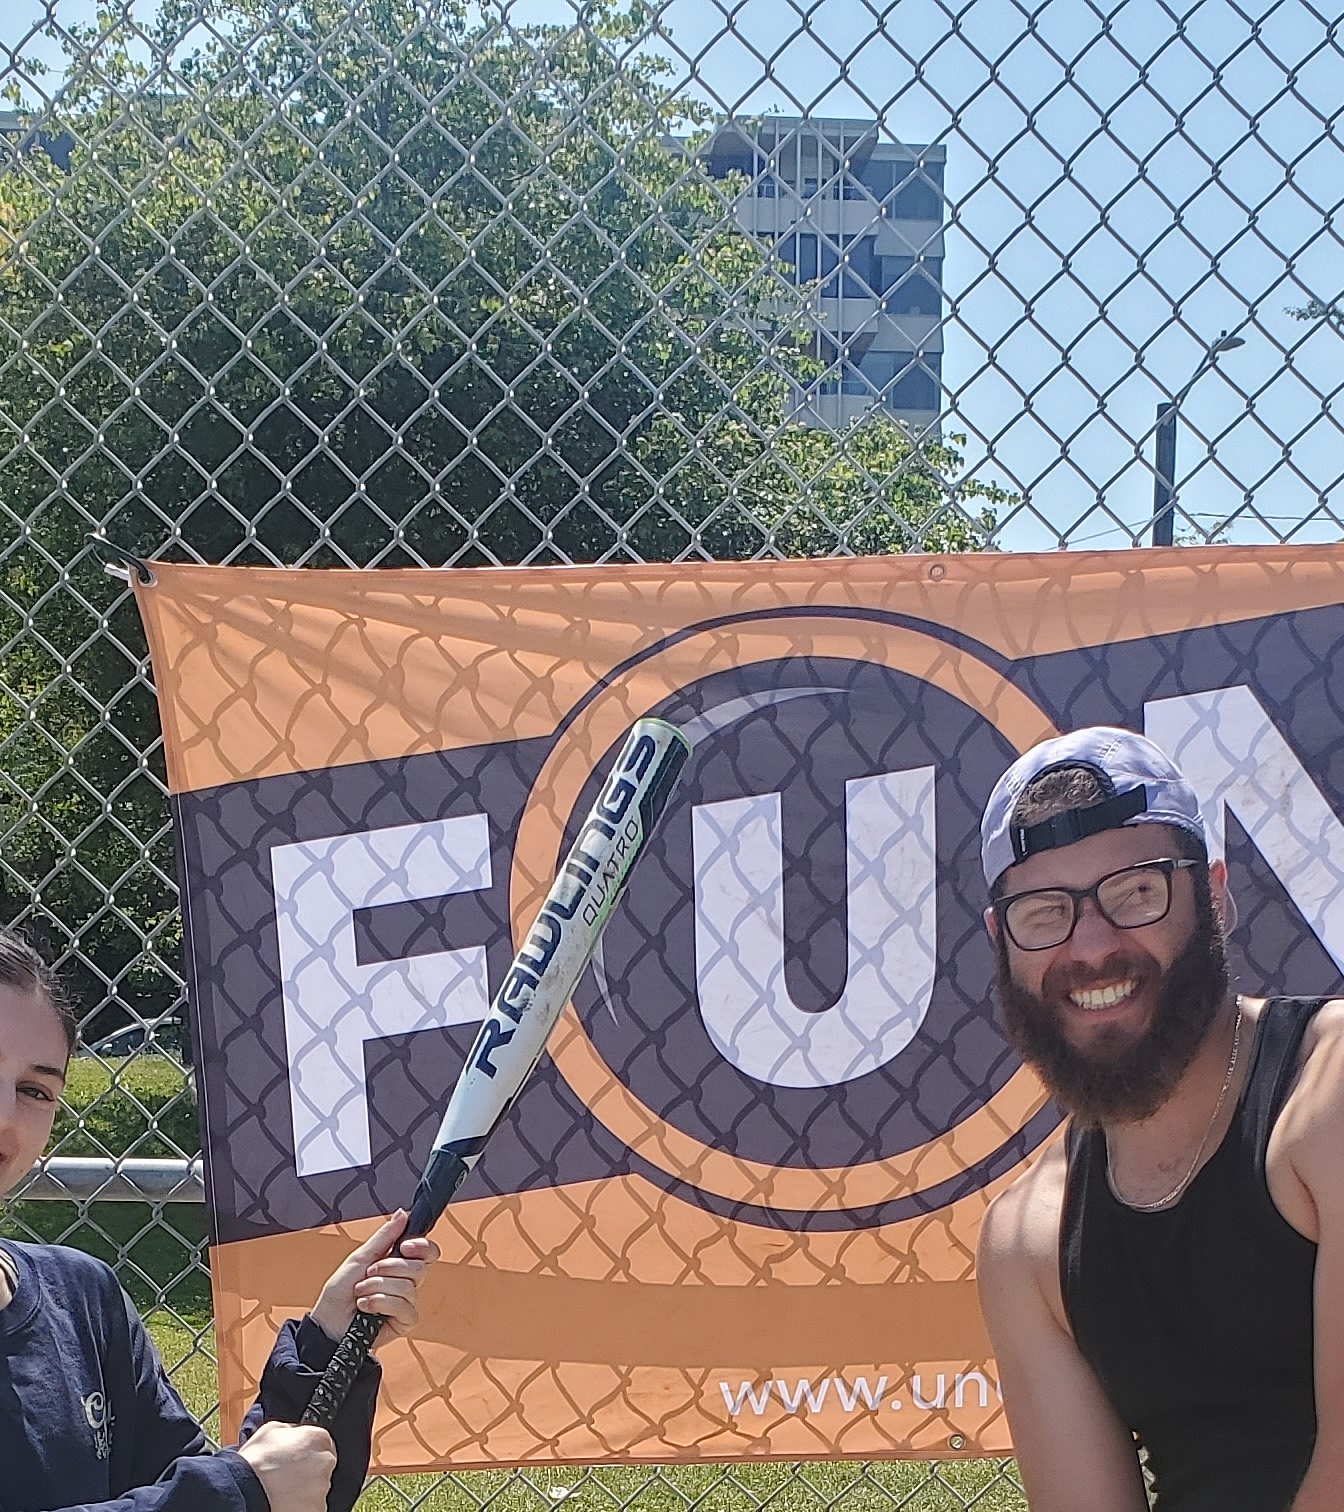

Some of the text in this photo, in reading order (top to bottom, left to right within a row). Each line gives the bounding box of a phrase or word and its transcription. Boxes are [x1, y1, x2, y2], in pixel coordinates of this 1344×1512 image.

[465, 735, 656, 1080] RAWLINGS
[582, 817, 639, 928] QUATRO
[718, 1371, 1003, 1416] www.un
